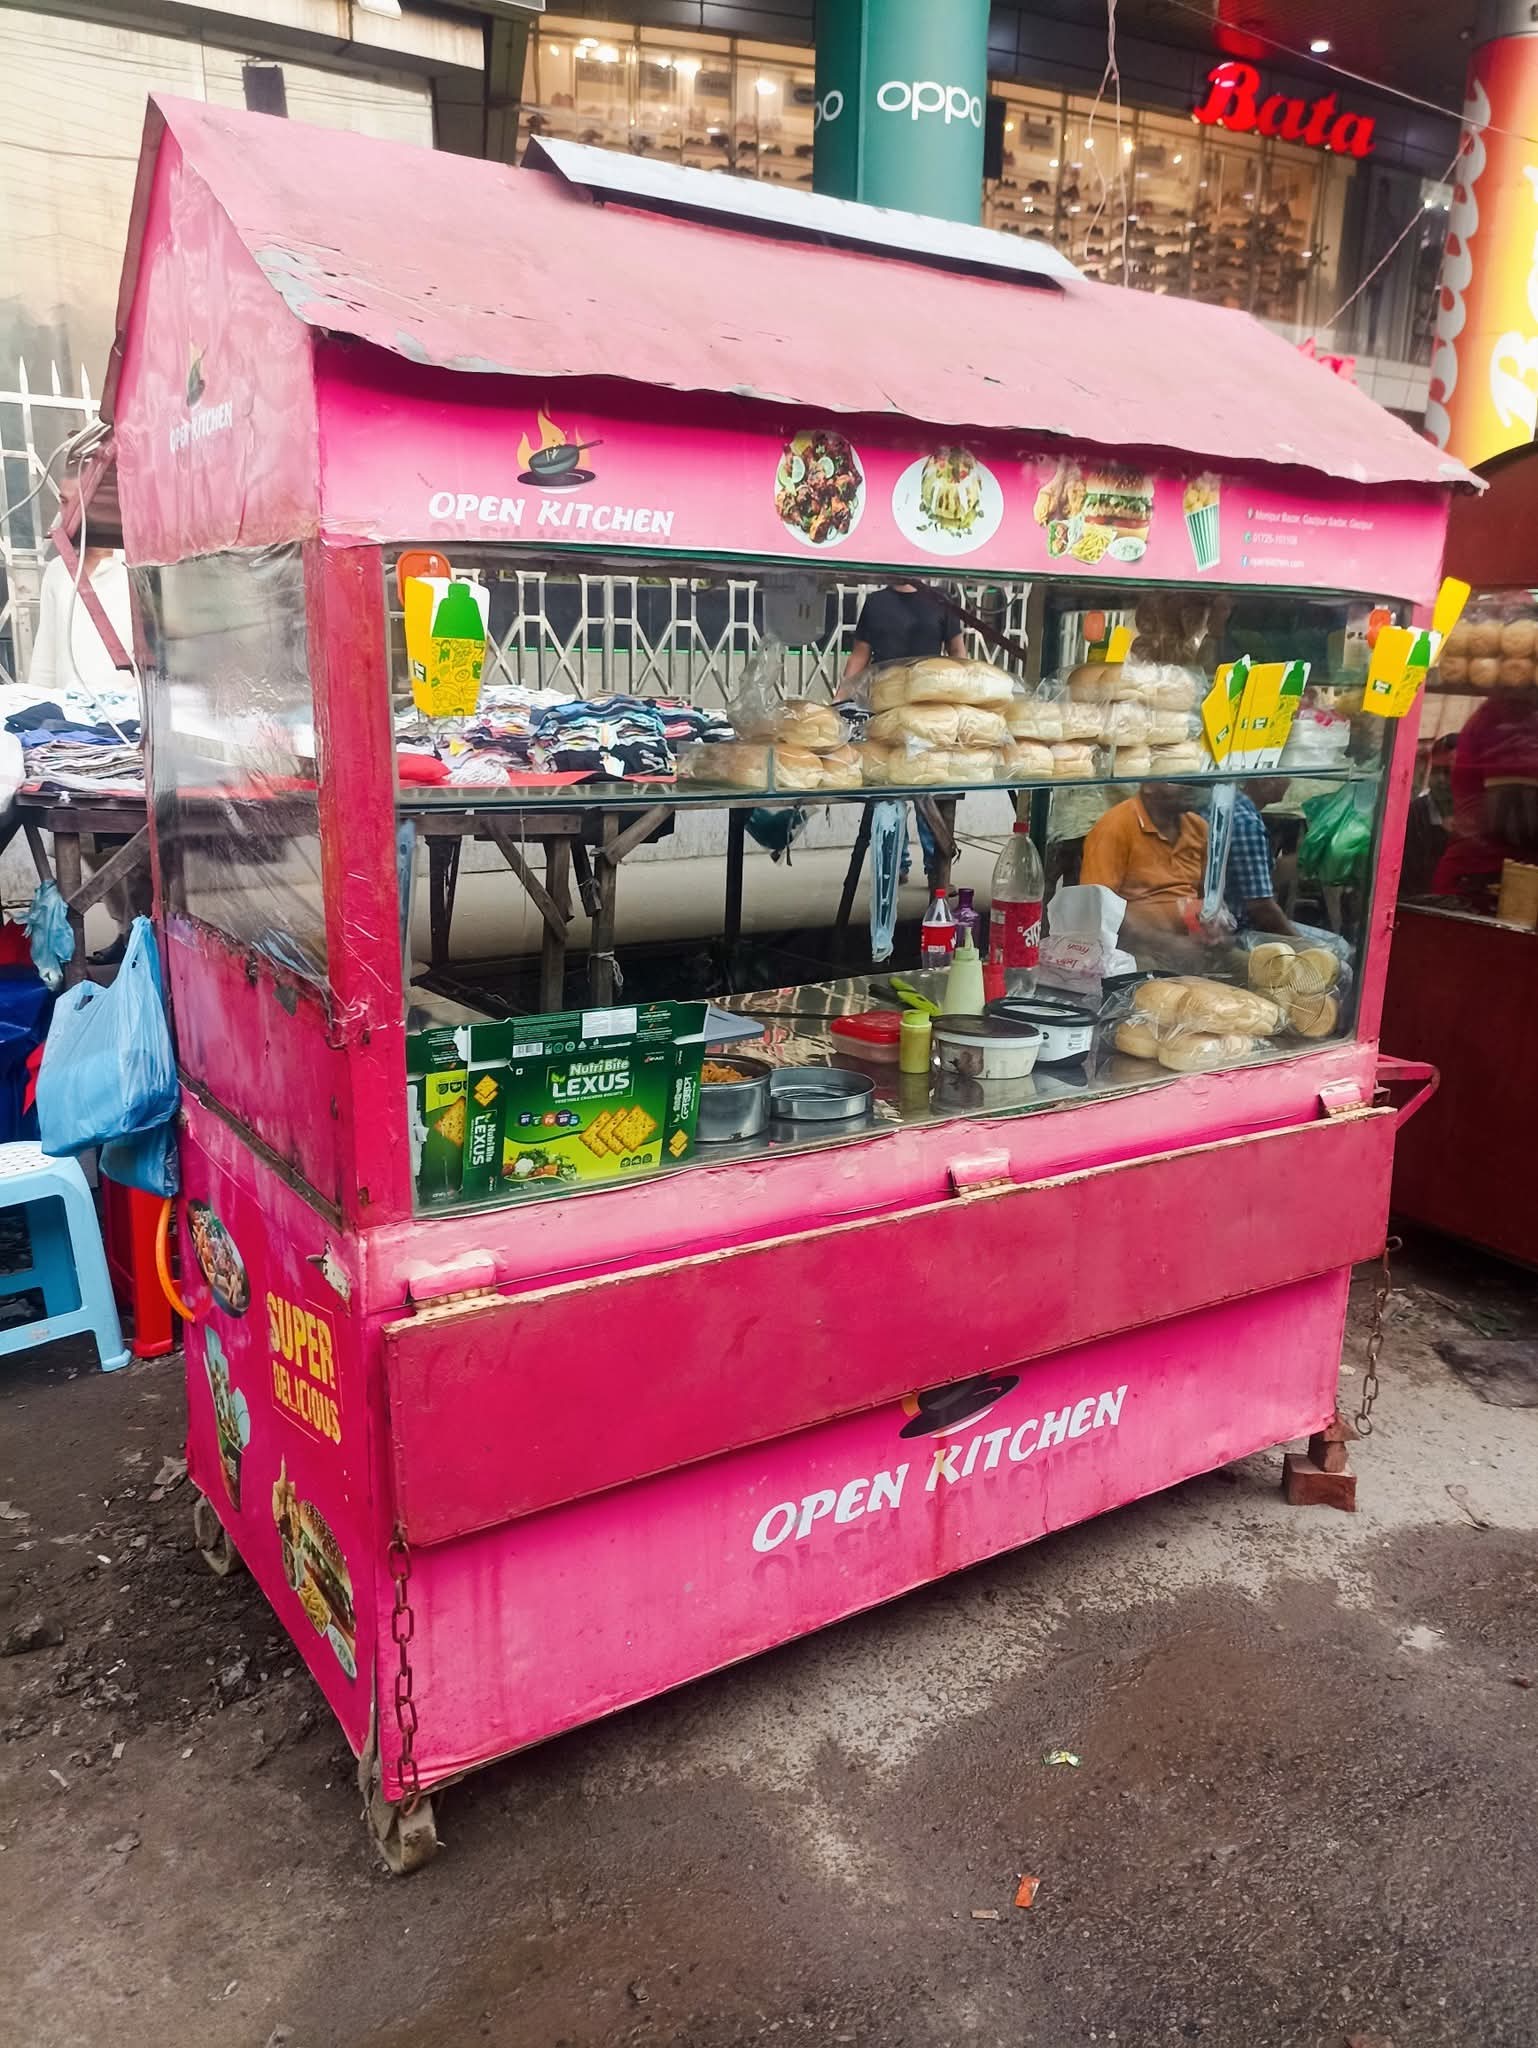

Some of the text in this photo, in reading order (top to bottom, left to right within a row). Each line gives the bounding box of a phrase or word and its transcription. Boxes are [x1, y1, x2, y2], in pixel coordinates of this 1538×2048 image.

[876, 80, 983, 128] oppo
[1193, 62, 1376, 159] Bata
[428, 492, 675, 536] OPEN KITCHEN
[552, 1071, 630, 1098] LEXUS
[473, 1115, 486, 1166] LEXUS
[266, 1291, 337, 1390] SUPER
[272, 1360, 342, 1446] DELICIOUS
[752, 1384, 1129, 1553] OPEN KITCHEN
